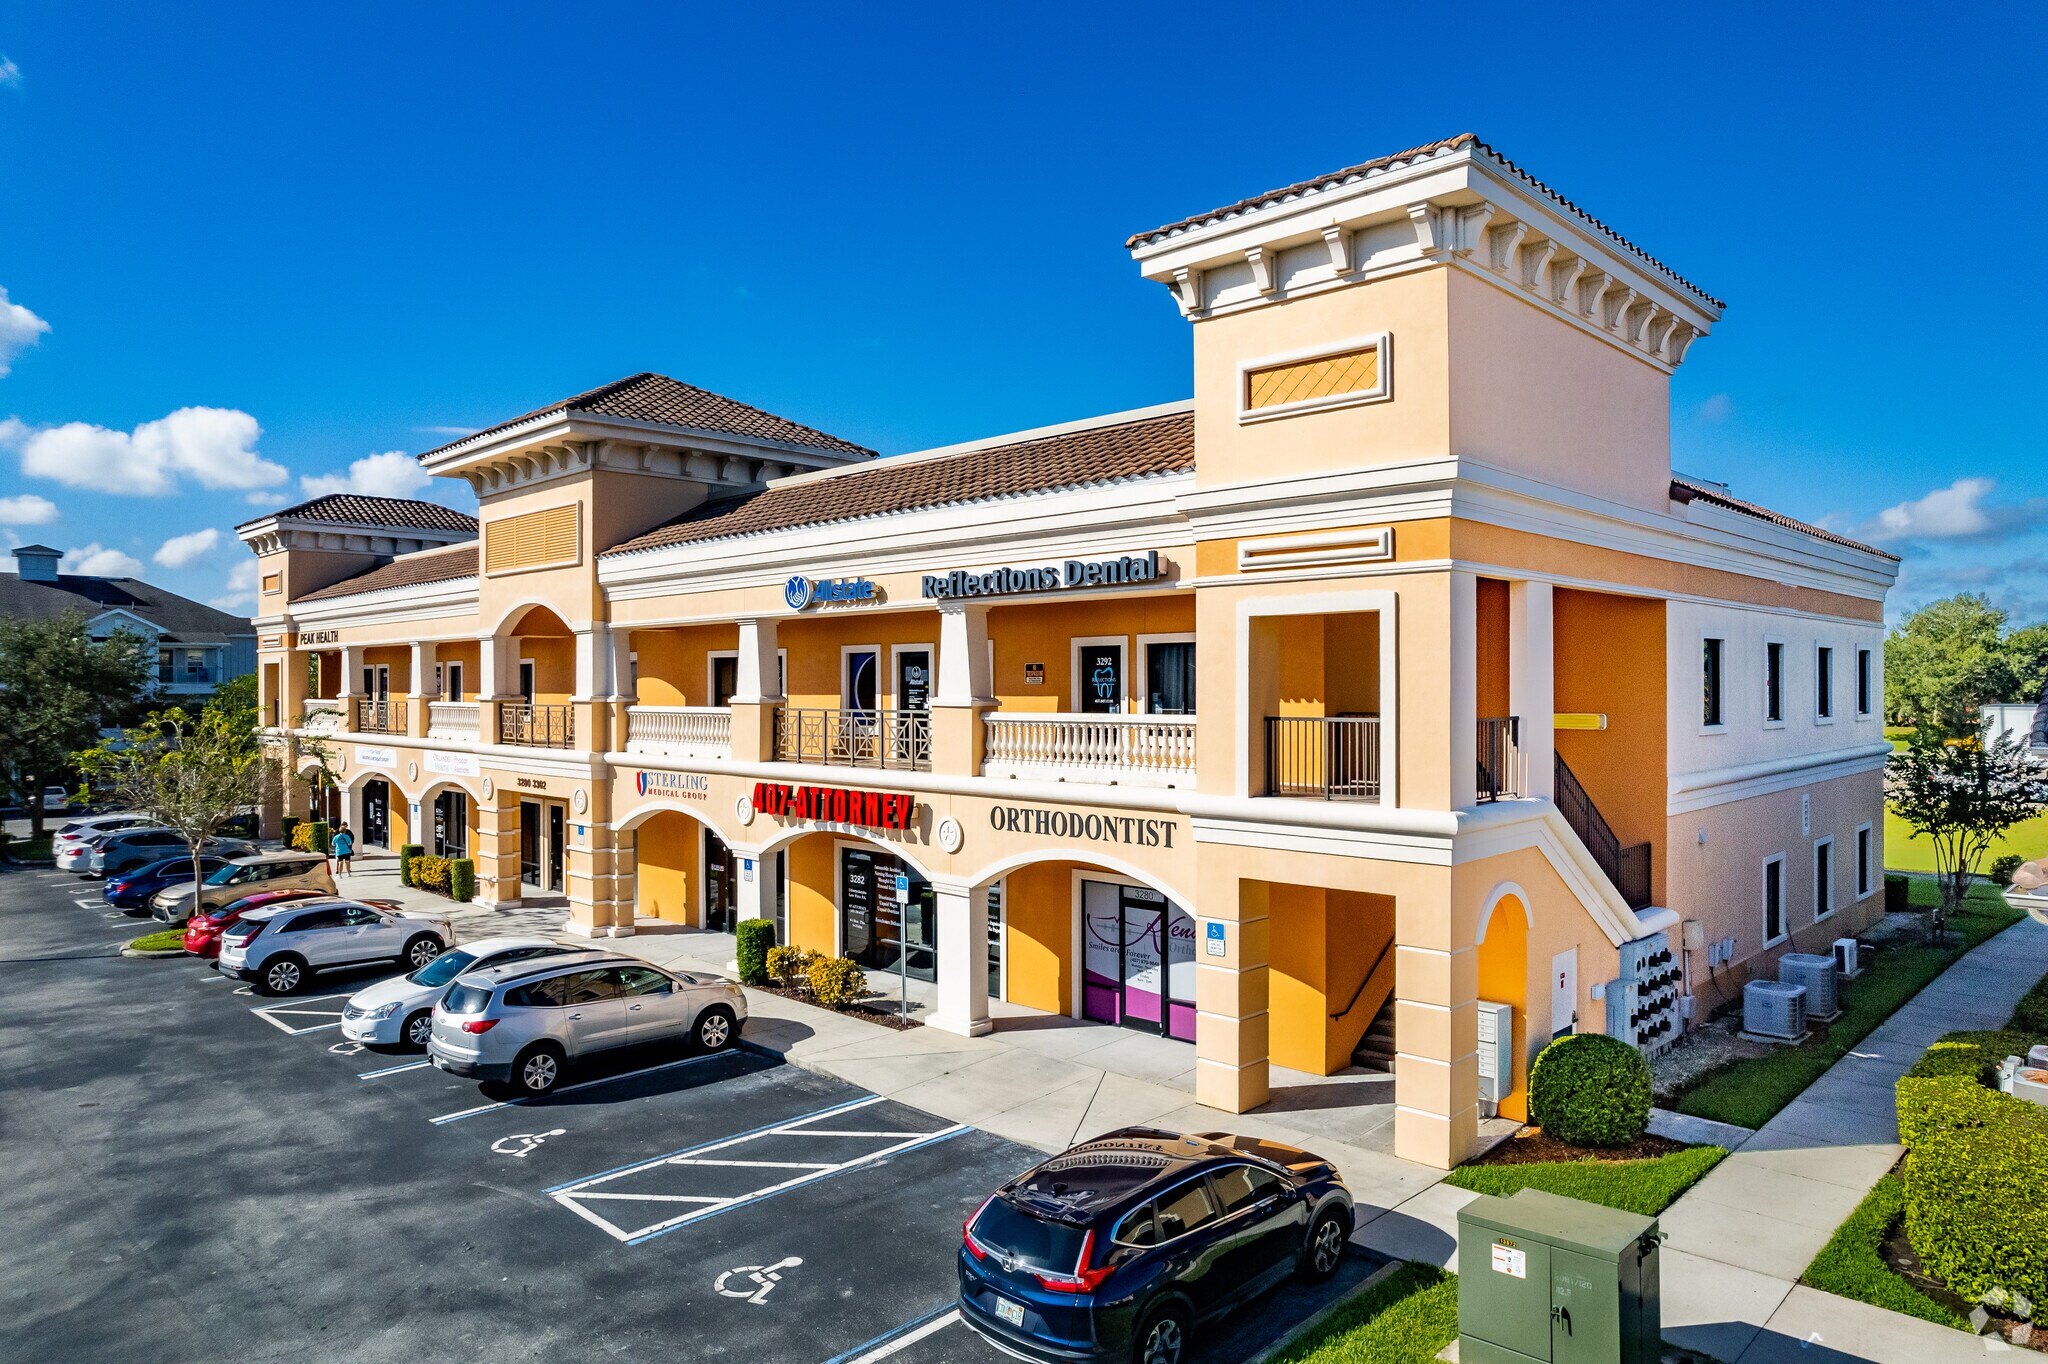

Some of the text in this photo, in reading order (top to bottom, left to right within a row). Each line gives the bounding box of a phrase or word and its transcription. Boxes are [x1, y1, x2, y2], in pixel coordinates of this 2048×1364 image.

[922, 550, 1159, 599] Reflections Dental
[812, 577, 873, 603] Allstate
[300, 630, 339, 645] PEAK HEALTH
[1095, 657, 1112, 666] 3292
[648, 771, 708, 791] STERLING
[648, 788, 707, 801] MEDICAL GROUP
[753, 783, 914, 830] 407-ATTORNEY
[990, 805, 1177, 849] ORTHODONTIST
[849, 874, 865, 885] 3282
[1135, 890, 1154, 901] 3280
[1088, 942, 1109, 952] Smiles
[1126, 949, 1151, 960] Forever
